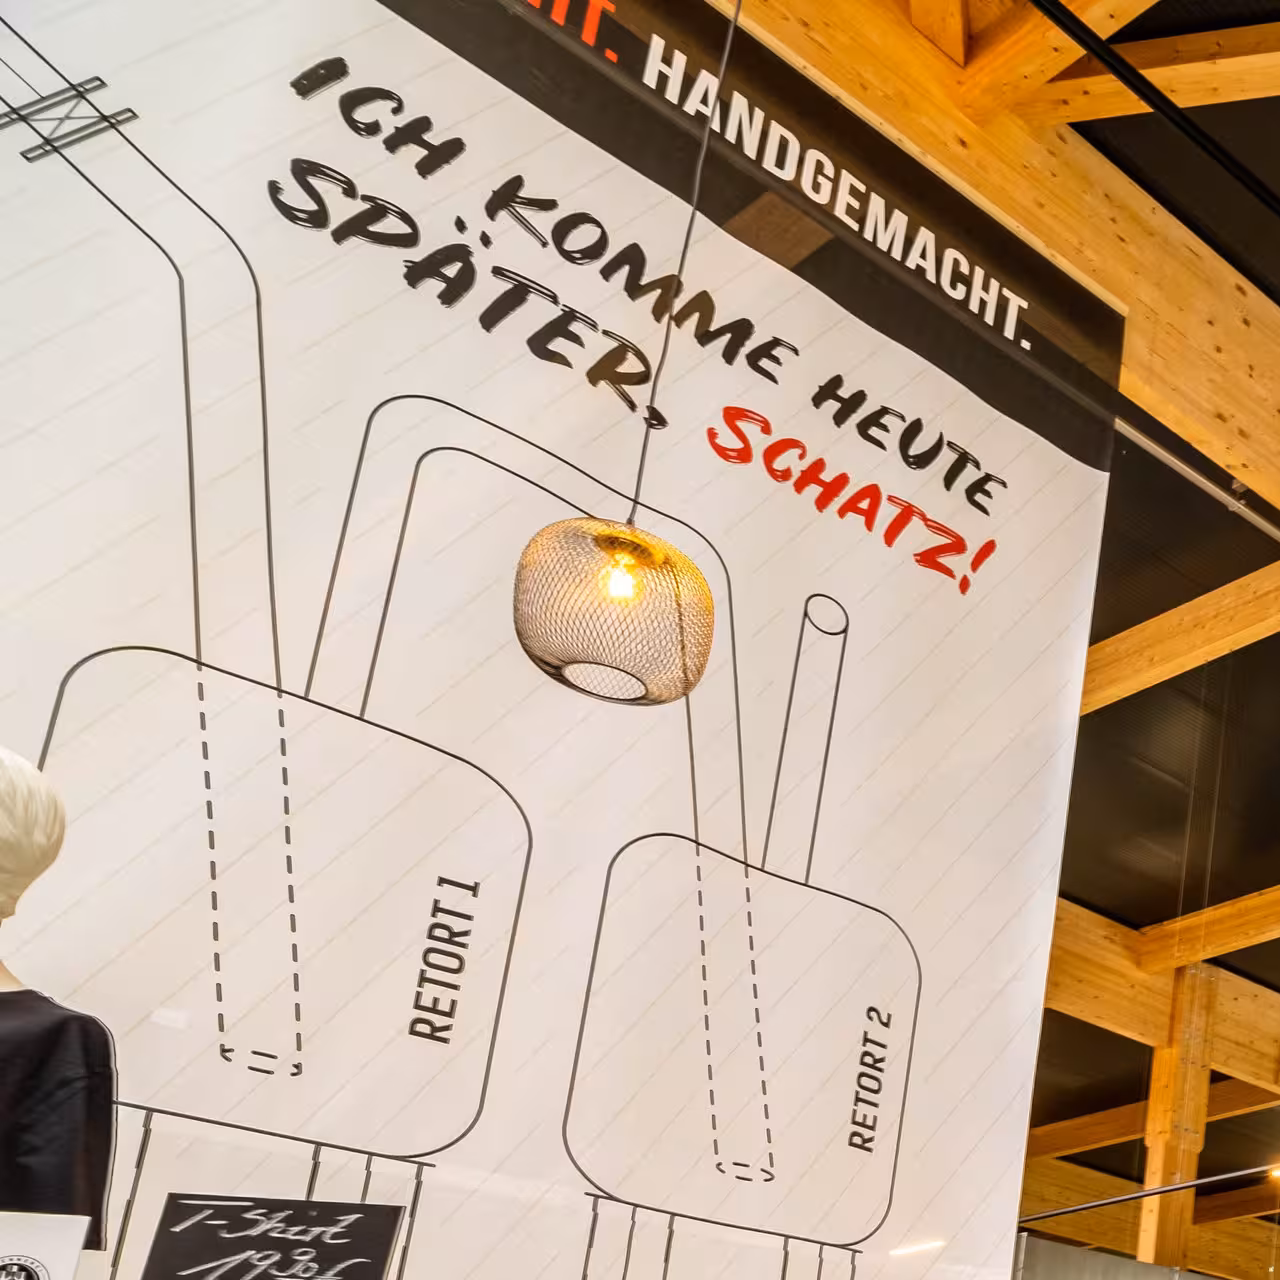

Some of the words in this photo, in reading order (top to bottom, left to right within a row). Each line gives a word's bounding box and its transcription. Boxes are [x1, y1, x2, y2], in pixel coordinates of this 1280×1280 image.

[642, 33, 1033, 351] HANDGEMACHT.
[290, 56, 466, 179] ICH
[485, 175, 799, 384] KOMME
[811, 375, 1007, 516] HEUTE
[707, 406, 996, 594] SCHATZ!
[437, 876, 481, 898] 1
[408, 898, 474, 1044] RETORT
[866, 1006, 892, 1029] 2
[848, 1030, 888, 1153] RETORT
[169, 1199, 366, 1243] T-Shirt
